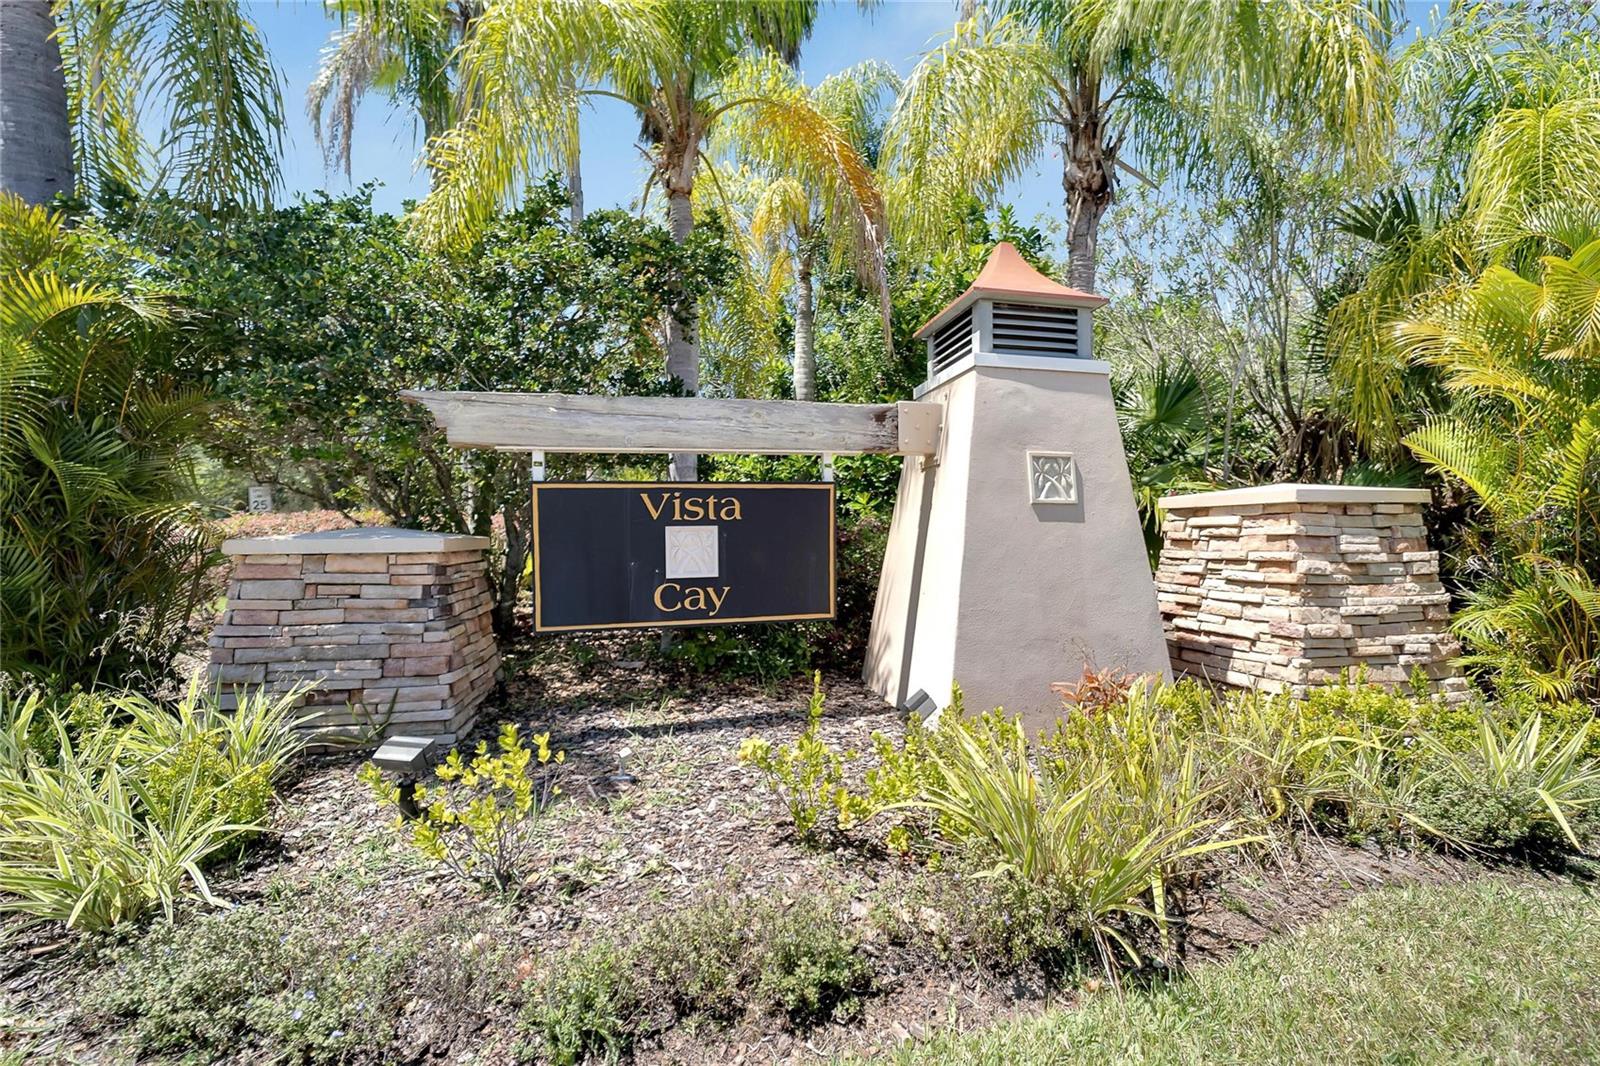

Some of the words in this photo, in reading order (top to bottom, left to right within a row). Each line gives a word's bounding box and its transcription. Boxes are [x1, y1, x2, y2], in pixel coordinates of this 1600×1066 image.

[252, 499, 268, 510] 25
[640, 492, 742, 521] Vista
[653, 582, 731, 617] Cay
